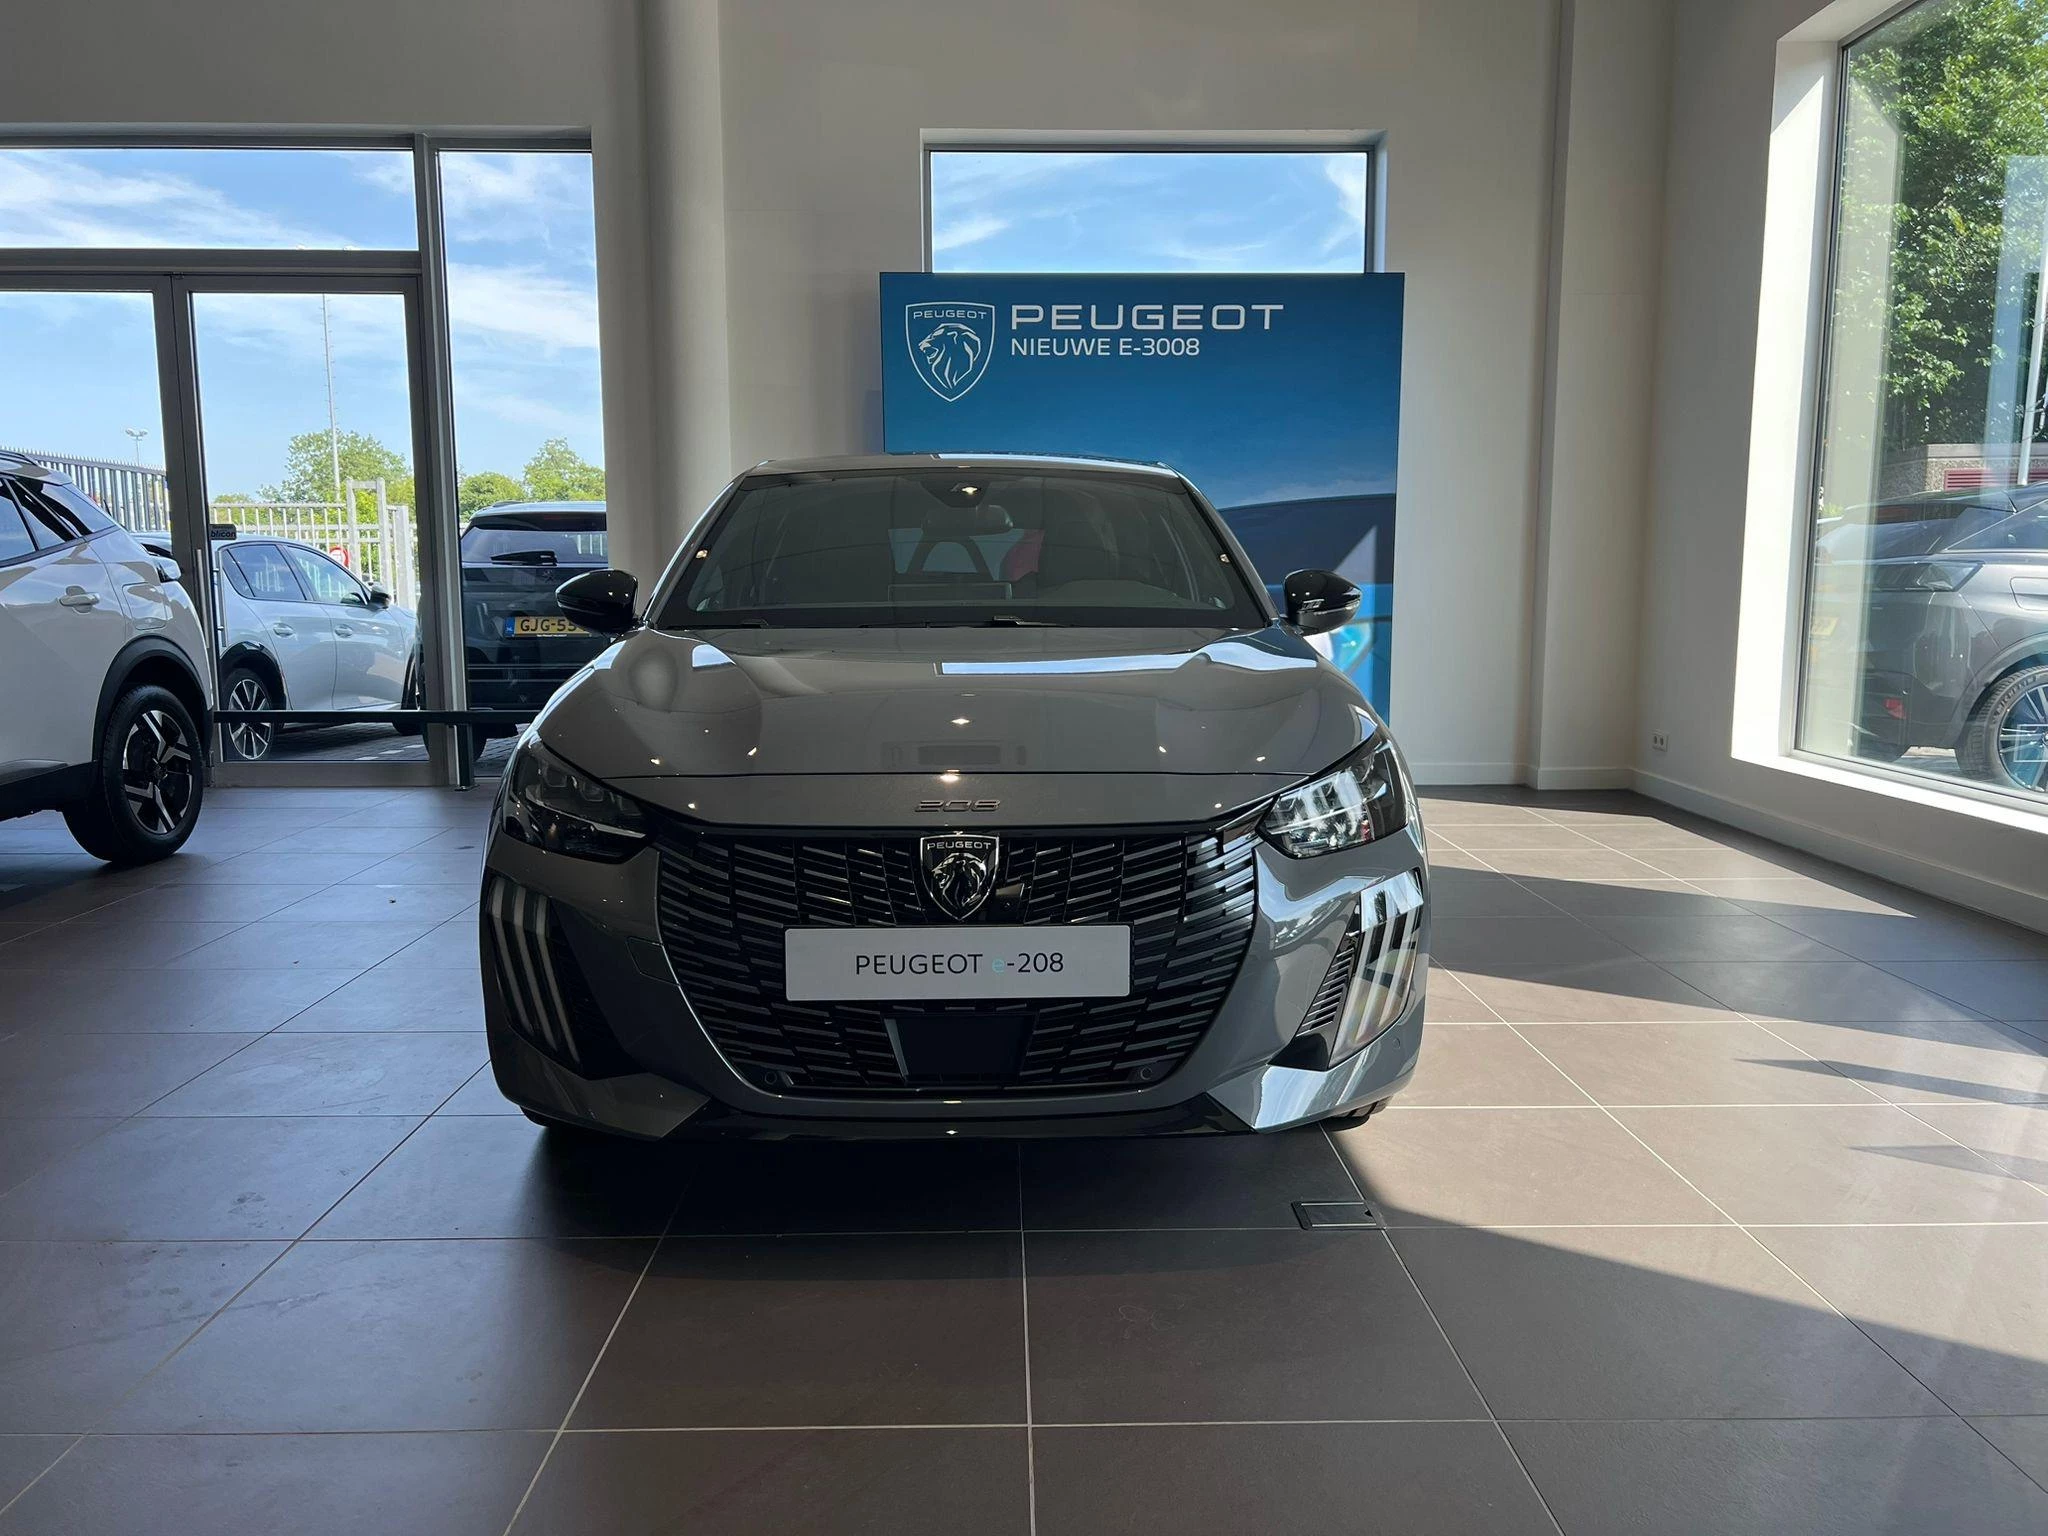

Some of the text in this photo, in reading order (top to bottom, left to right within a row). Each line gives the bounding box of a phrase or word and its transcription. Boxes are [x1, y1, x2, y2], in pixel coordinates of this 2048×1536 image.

[913, 309, 987, 320] PEUGEOT
[1011, 304, 1285, 331] PEUGEOT
[1011, 338, 1200, 356] NIEUWE E-3008
[915, 800, 1000, 813] 208
[926, 840, 992, 851] PEUGEOT
[855, 952, 1064, 975] PEUGEOT e-208
